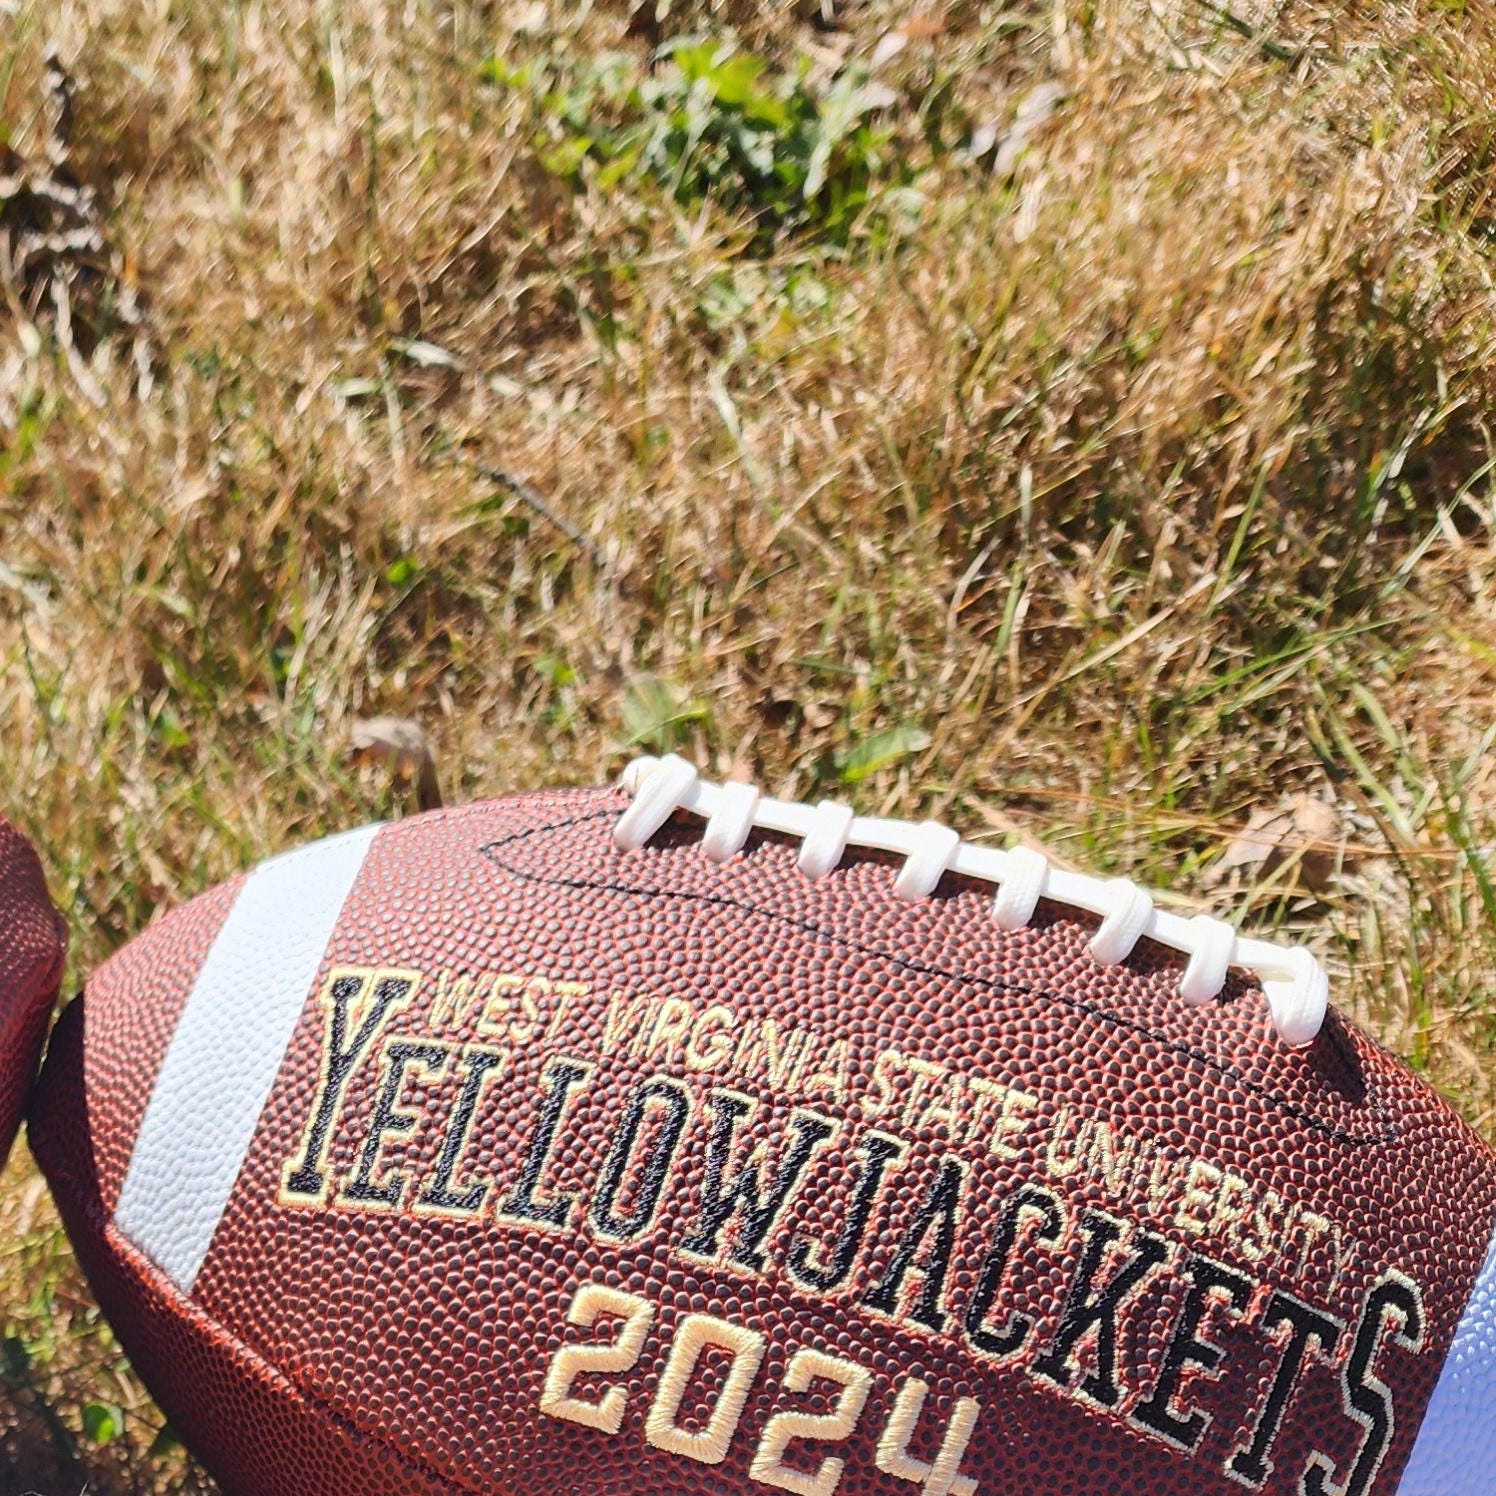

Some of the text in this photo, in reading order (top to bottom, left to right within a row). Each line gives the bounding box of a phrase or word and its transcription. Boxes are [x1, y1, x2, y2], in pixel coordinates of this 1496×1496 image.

[423, 968, 1355, 1301] WEST VIRGINIA STATE UNIVERSITY
